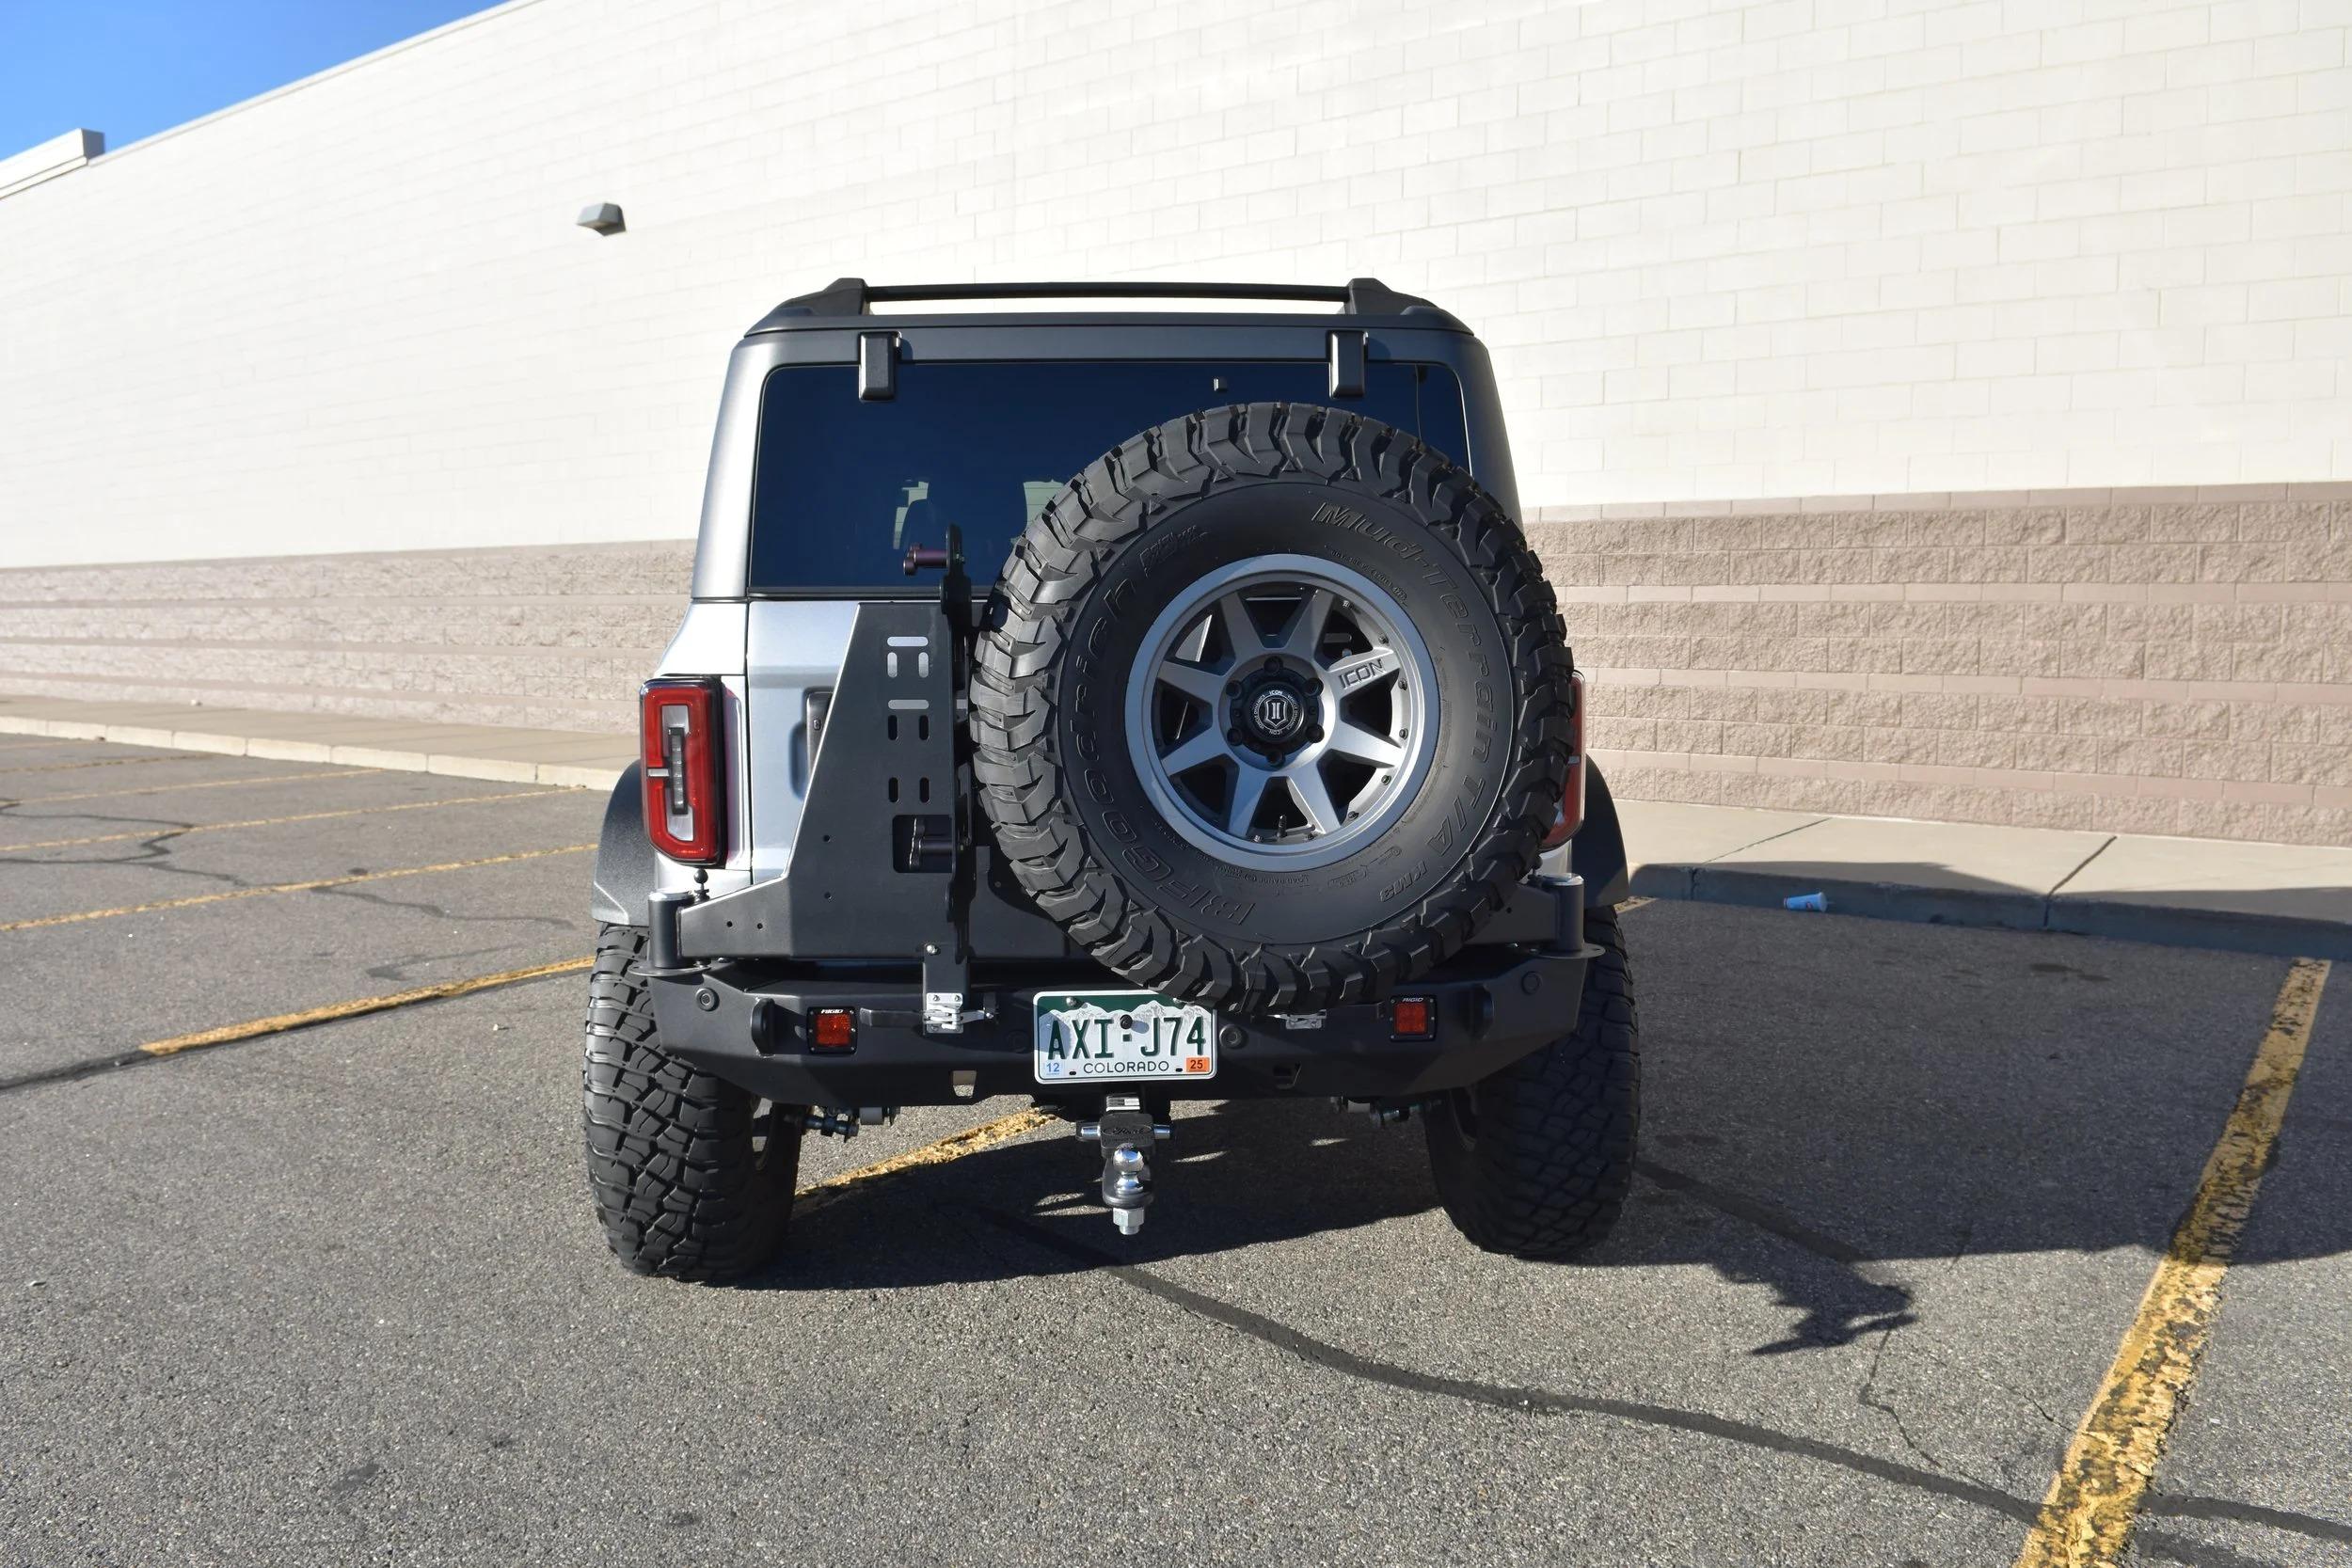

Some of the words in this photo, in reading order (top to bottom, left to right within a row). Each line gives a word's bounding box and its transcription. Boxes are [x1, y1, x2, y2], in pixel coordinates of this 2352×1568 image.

[1311, 501, 1498, 764] Mud-Terrain
[1338, 658, 1387, 689] ICON
[1425, 774, 1486, 857] T/A
[1378, 860, 1428, 903] KM3
[1046, 1062, 1060, 1073] 12
[1083, 1060, 1169, 1074] COLORADO
[1189, 1059, 1204, 1069] 25
